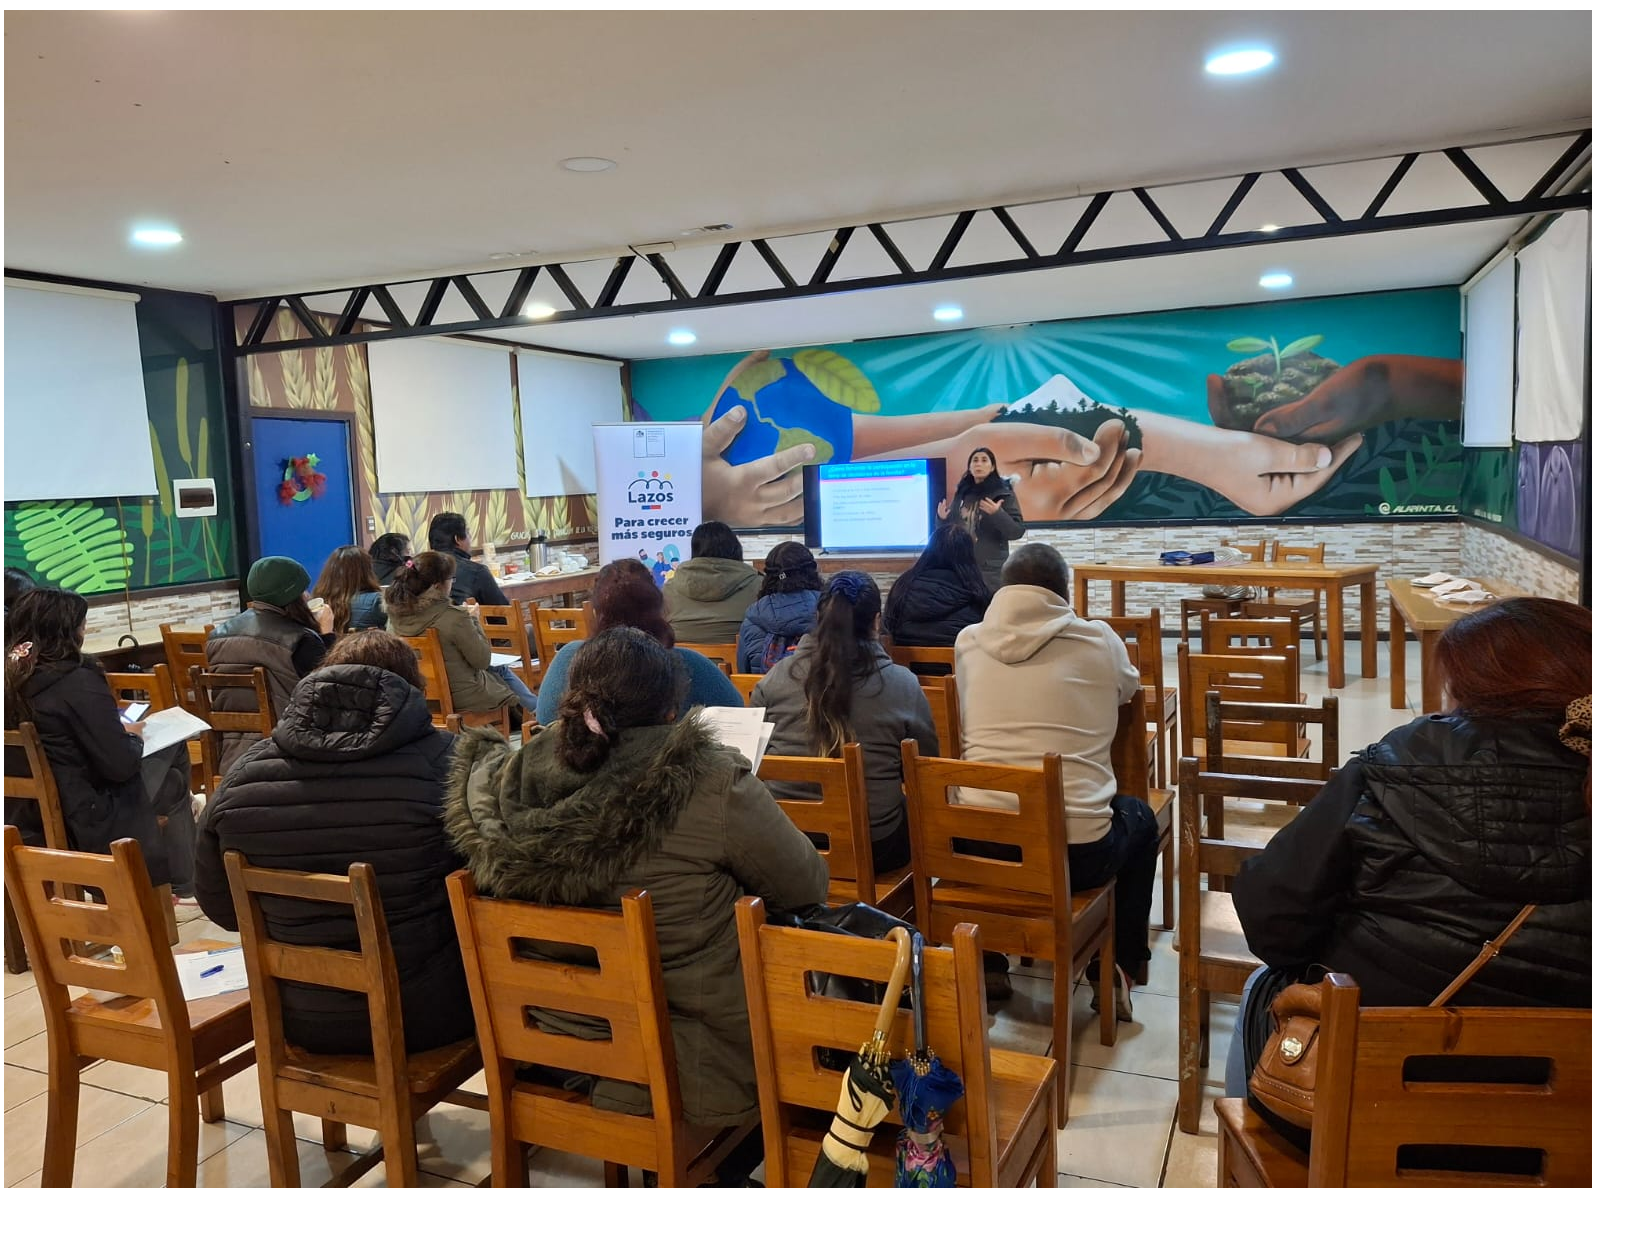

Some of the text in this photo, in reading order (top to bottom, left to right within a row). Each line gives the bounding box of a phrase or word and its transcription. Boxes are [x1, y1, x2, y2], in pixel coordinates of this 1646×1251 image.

[628, 491, 674, 503] Lazos
[615, 517, 689, 528] Para crecer
[611, 529, 638, 540] más
[641, 529, 693, 541] seguros
